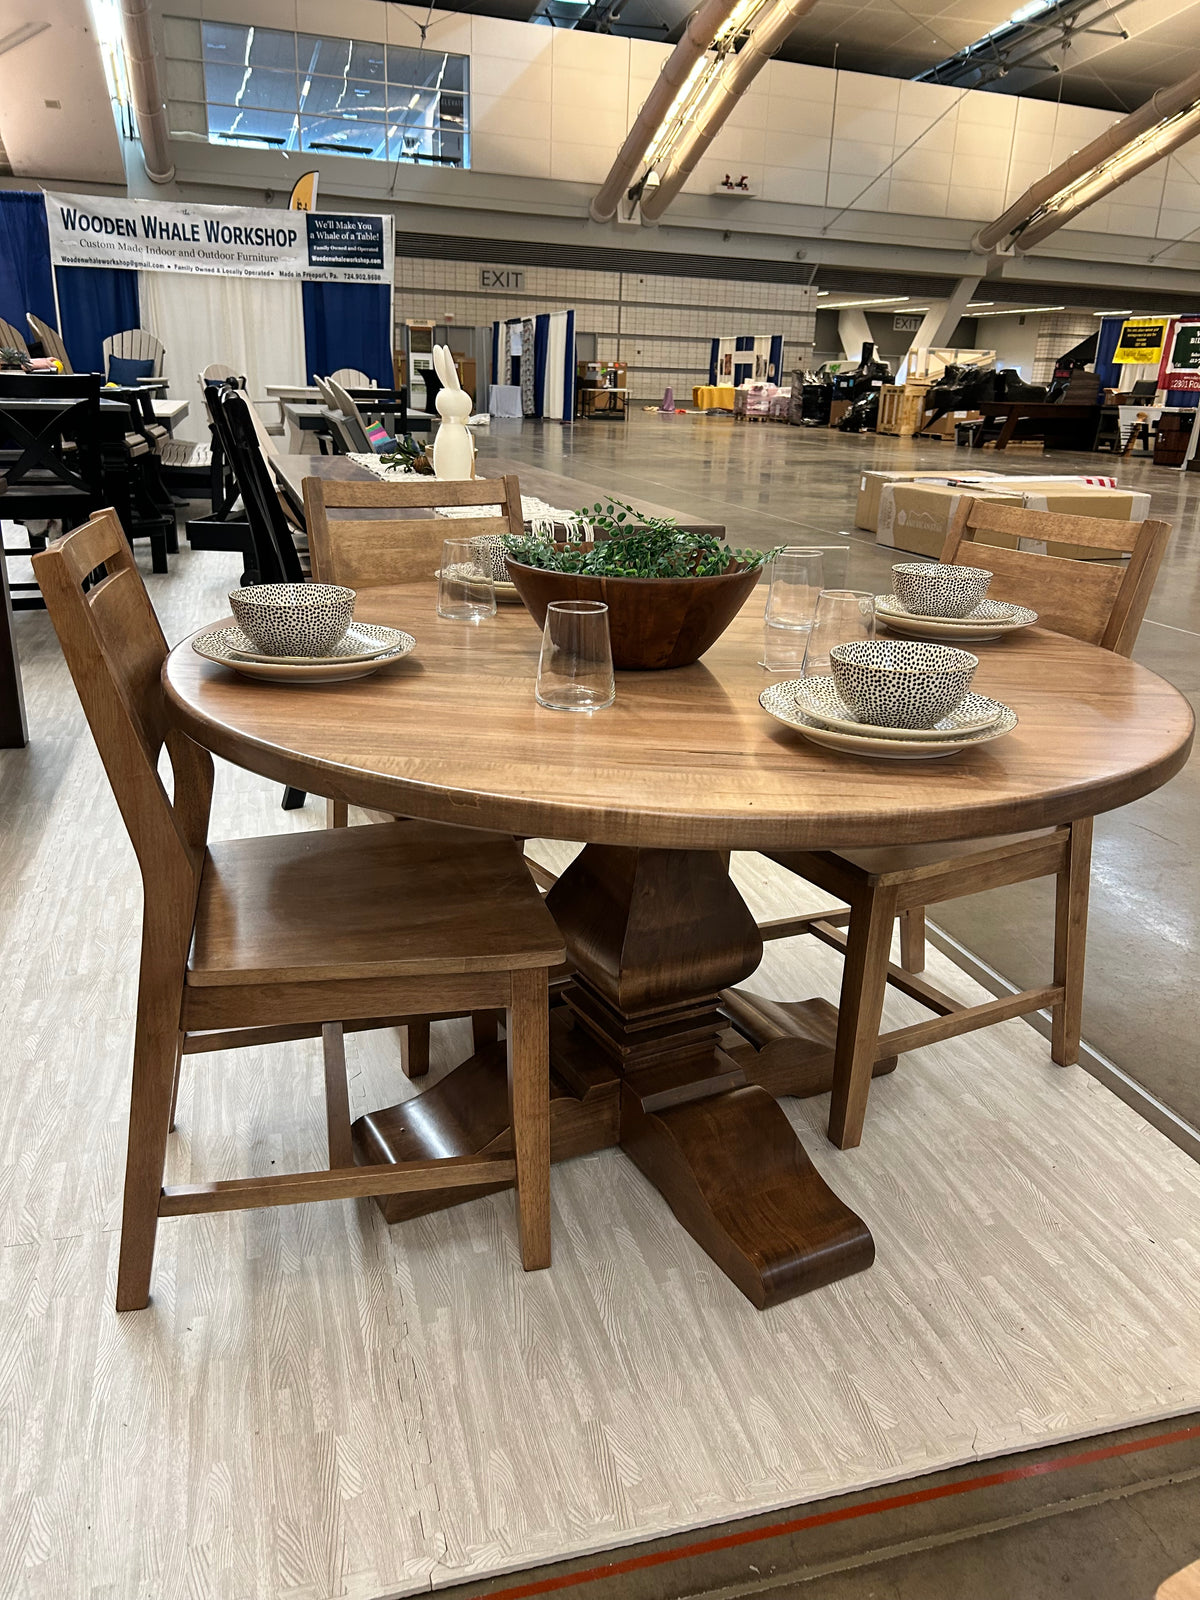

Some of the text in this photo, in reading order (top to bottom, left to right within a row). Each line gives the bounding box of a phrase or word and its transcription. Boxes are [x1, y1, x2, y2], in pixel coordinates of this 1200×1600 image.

[60, 206, 297, 247] WOODEN WHALE WORKSHOP
[314, 220, 372, 231] We'll Make You
[316, 231, 340, 240] Whale
[341, 232, 350, 240] of
[356, 232, 379, 241] Table!
[79, 238, 279, 263] Custom Made Indoor and Outdoor Furniture
[174, 264, 193, 272] Family
[222, 268, 242, 276] Locally
[244, 269, 270, 277] Operated
[481, 270, 522, 288] EXIT
[895, 317, 920, 329] EXIT
